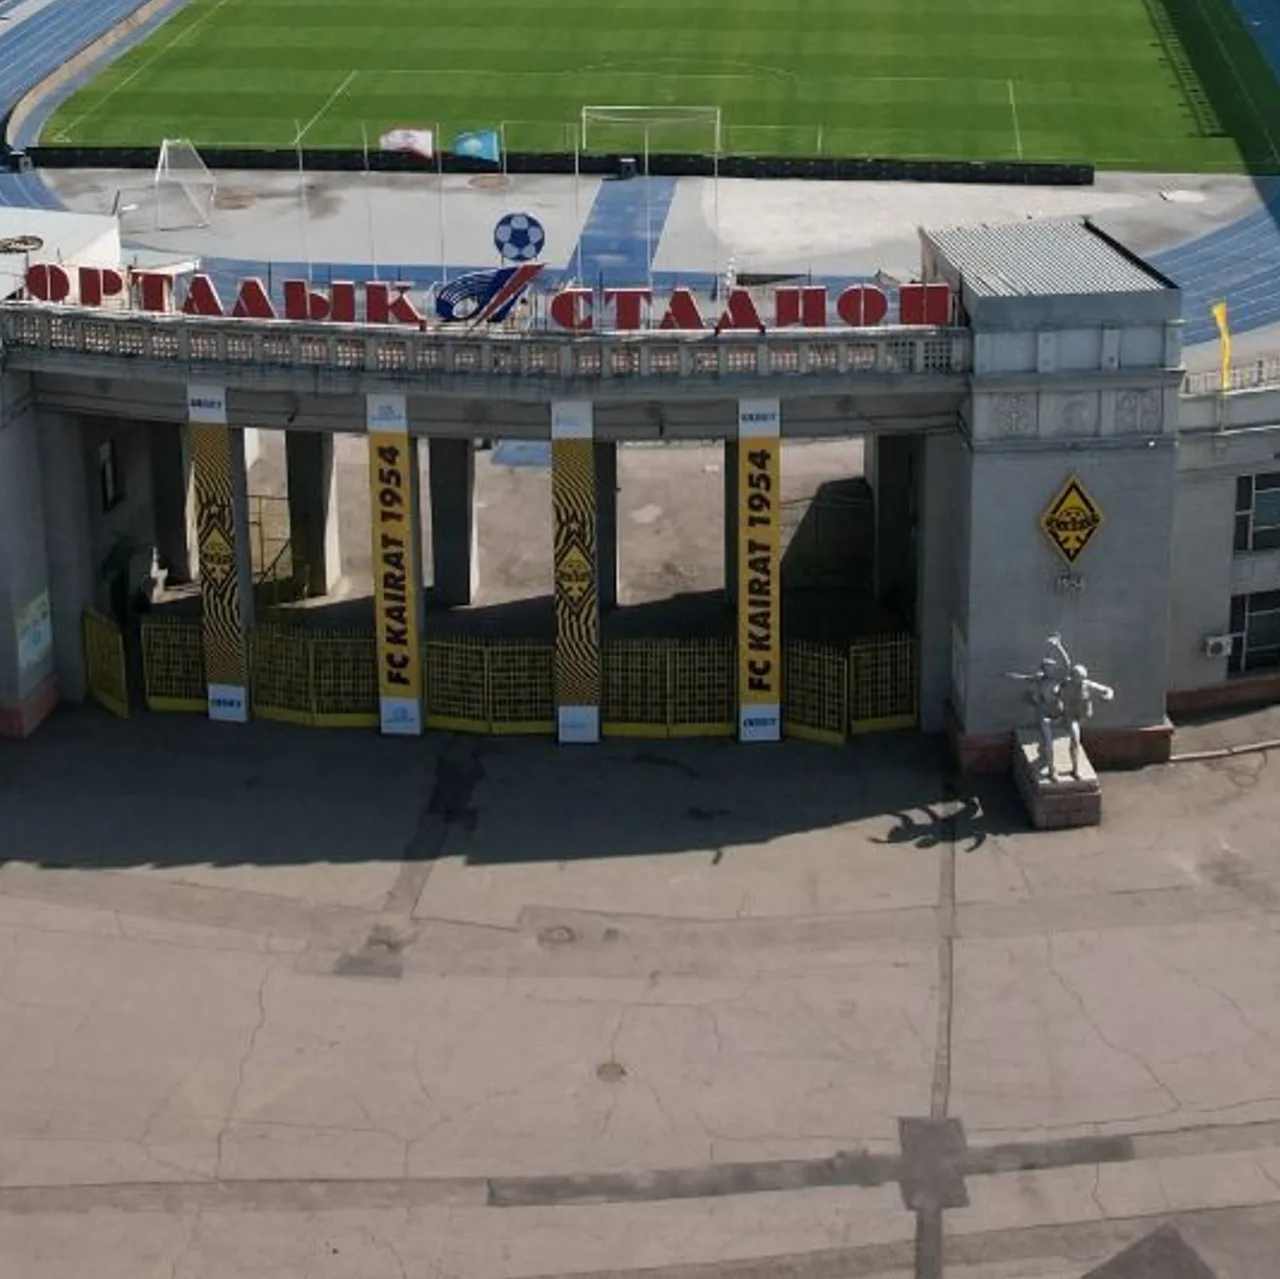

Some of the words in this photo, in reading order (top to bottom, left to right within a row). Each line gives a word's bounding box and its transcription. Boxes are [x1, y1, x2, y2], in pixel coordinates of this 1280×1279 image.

[377, 444, 404, 522] 1954
[747, 448, 771, 527] 1954
[380, 532, 409, 647] KAIRAT
[747, 539, 771, 652] KAIRAT
[386, 652, 410, 686] FC
[747, 659, 771, 692] FC
